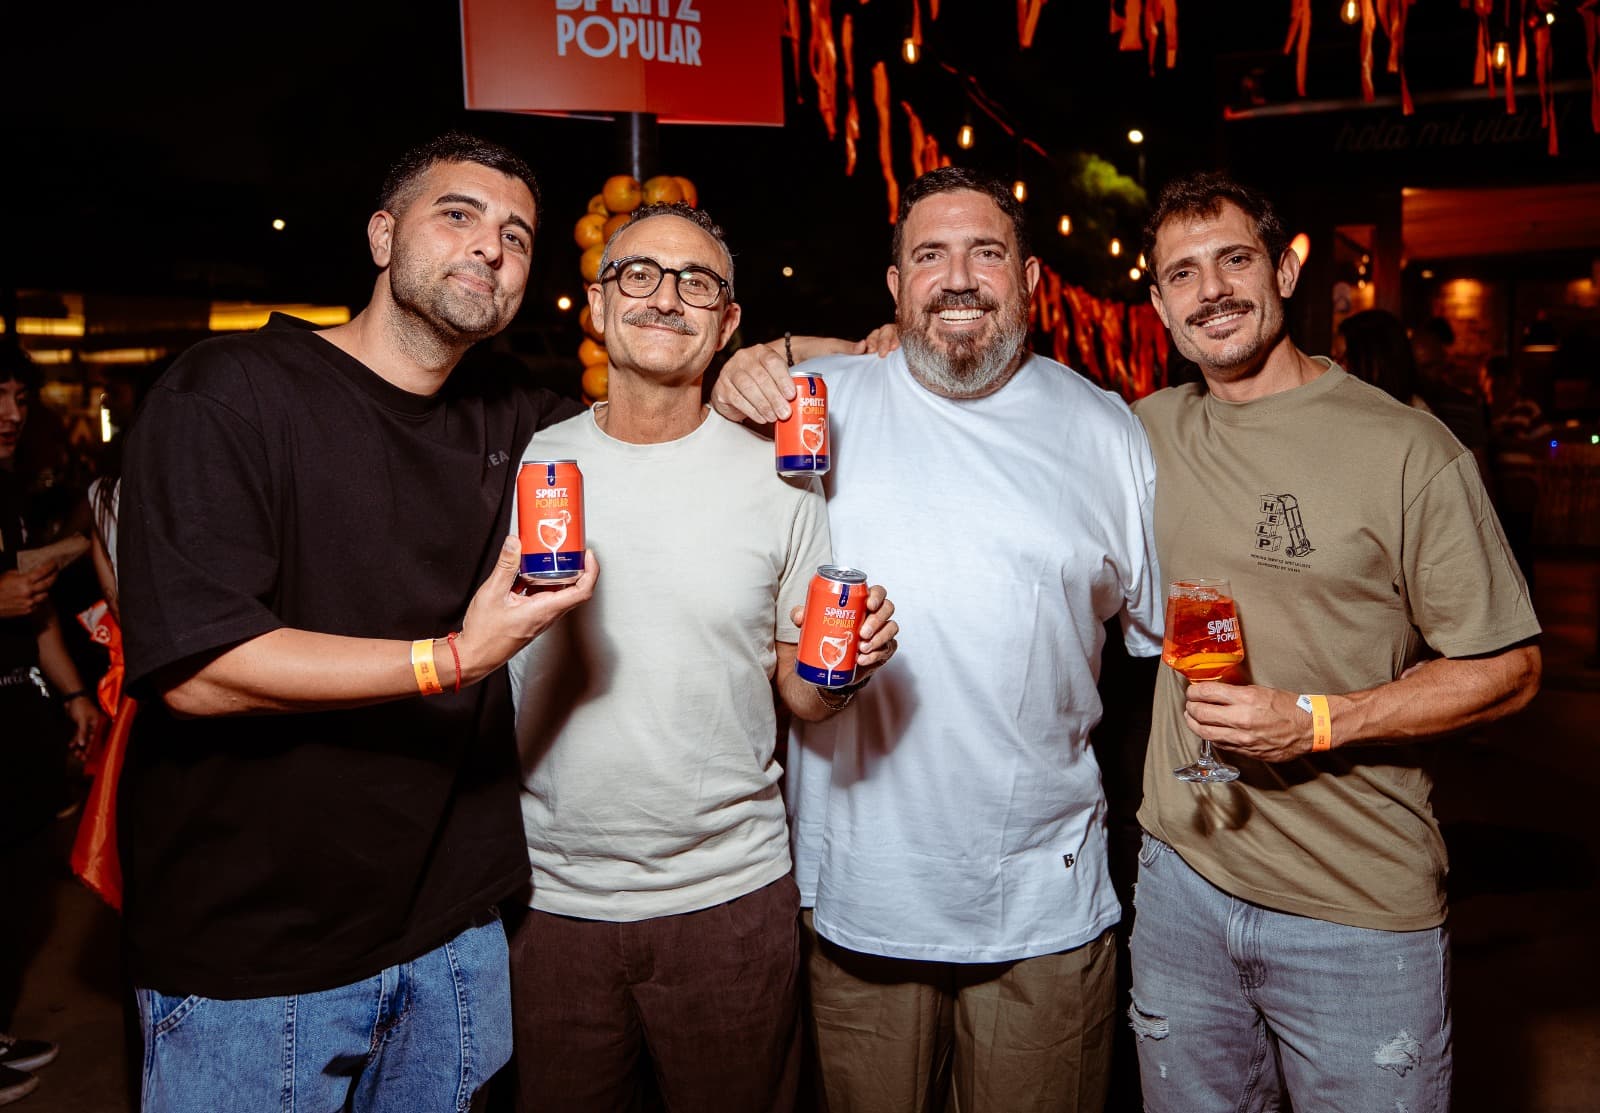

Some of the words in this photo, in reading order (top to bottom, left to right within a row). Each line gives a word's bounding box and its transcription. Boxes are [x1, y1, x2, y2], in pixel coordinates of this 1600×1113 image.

[555, 14, 702, 66] POPULAR
[535, 487, 569, 499] SPRITZ
[1258, 502, 1278, 548] HELP
[824, 606, 856, 620] SPRITZ
